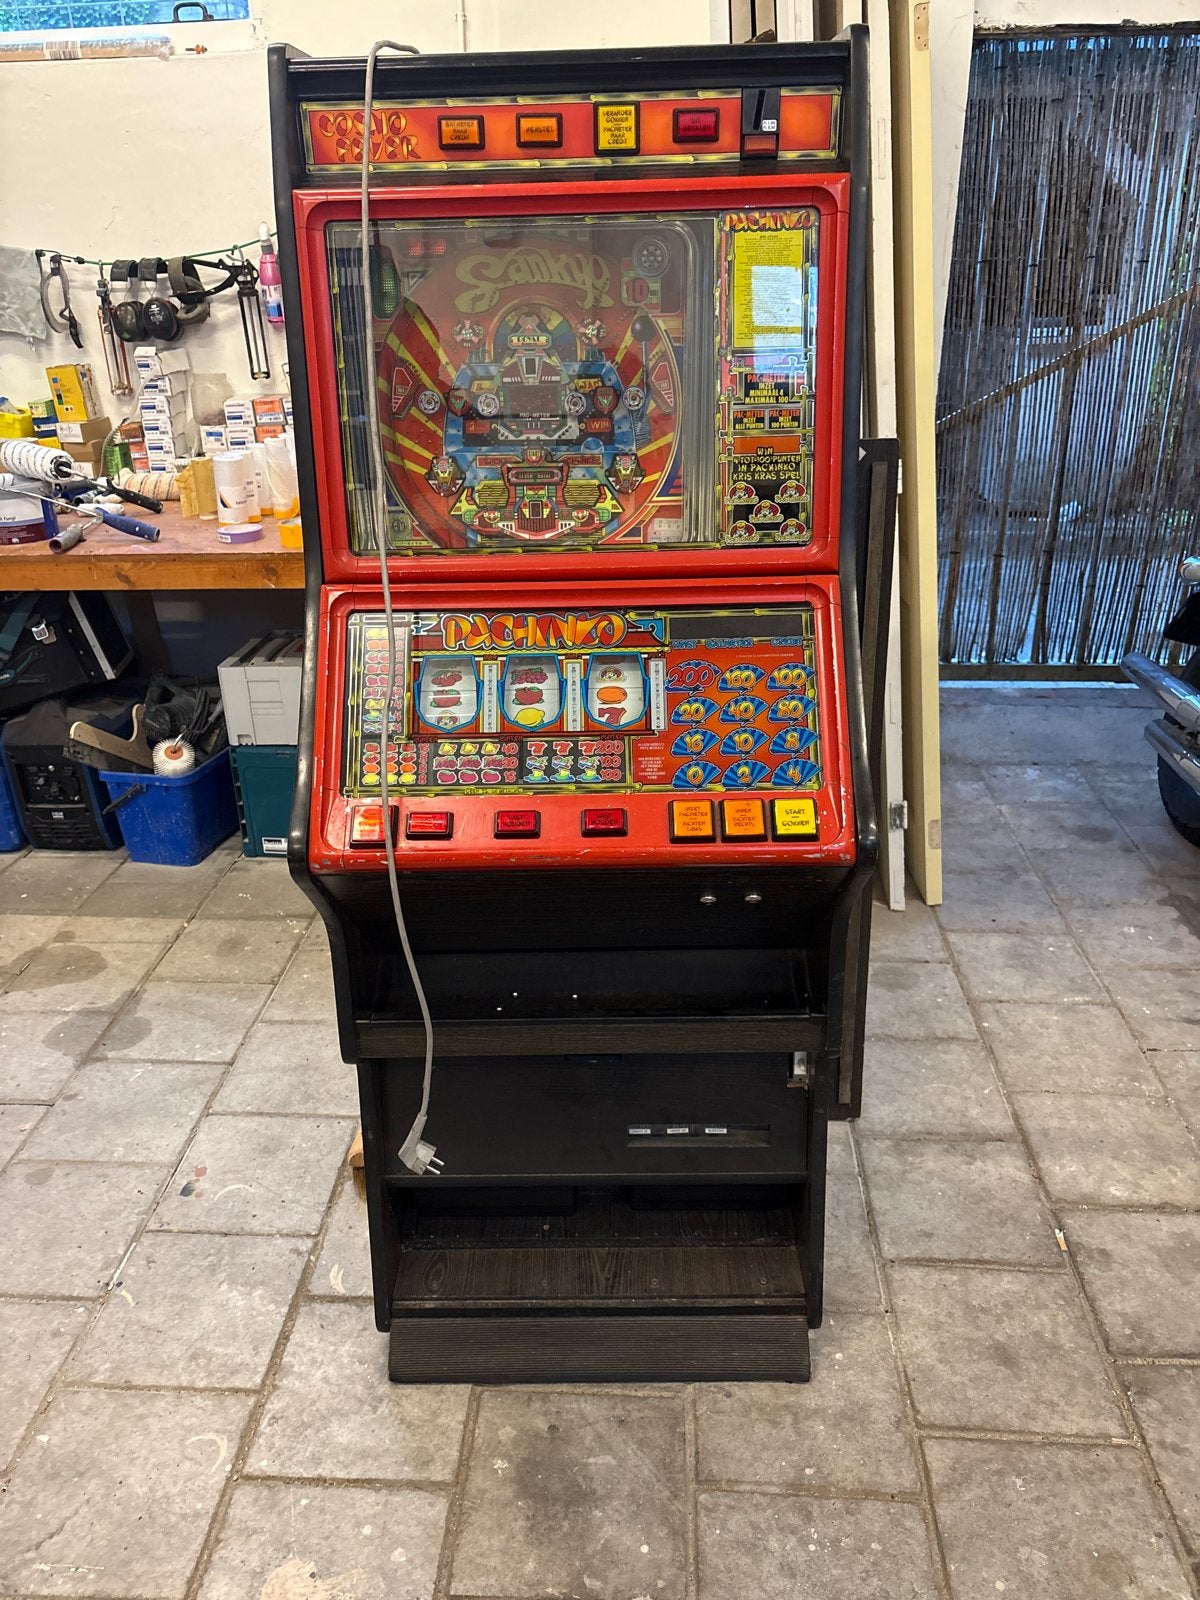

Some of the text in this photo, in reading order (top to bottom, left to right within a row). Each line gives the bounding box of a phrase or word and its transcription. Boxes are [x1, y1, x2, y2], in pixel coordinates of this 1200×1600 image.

[336, 135, 421, 162] FEVER
[723, 210, 817, 231] PACHINKO
[747, 374, 787, 383] PAC-METER
[741, 456, 755, 464] TOT
[757, 448, 774, 456] WIN
[733, 471, 800, 481] KRIS KRAS SPEL
[738, 463, 796, 472] IN PACHINKO
[442, 613, 628, 650] PACHINKO
[667, 665, 715, 687] 200
[772, 668, 807, 687] 100
[394, 699, 402, 709] 4
[679, 701, 705, 721] 20
[729, 701, 756, 720] 40
[777, 700, 804, 719] 80
[684, 734, 704, 752] 16
[733, 733, 755, 752] 10
[785, 731, 800, 750] 8
[600, 755, 622, 767] 100
[600, 768, 622, 781] 100
[686, 765, 704, 784] 0
[737, 765, 751, 784] 2
[787, 765, 801, 784] 4
